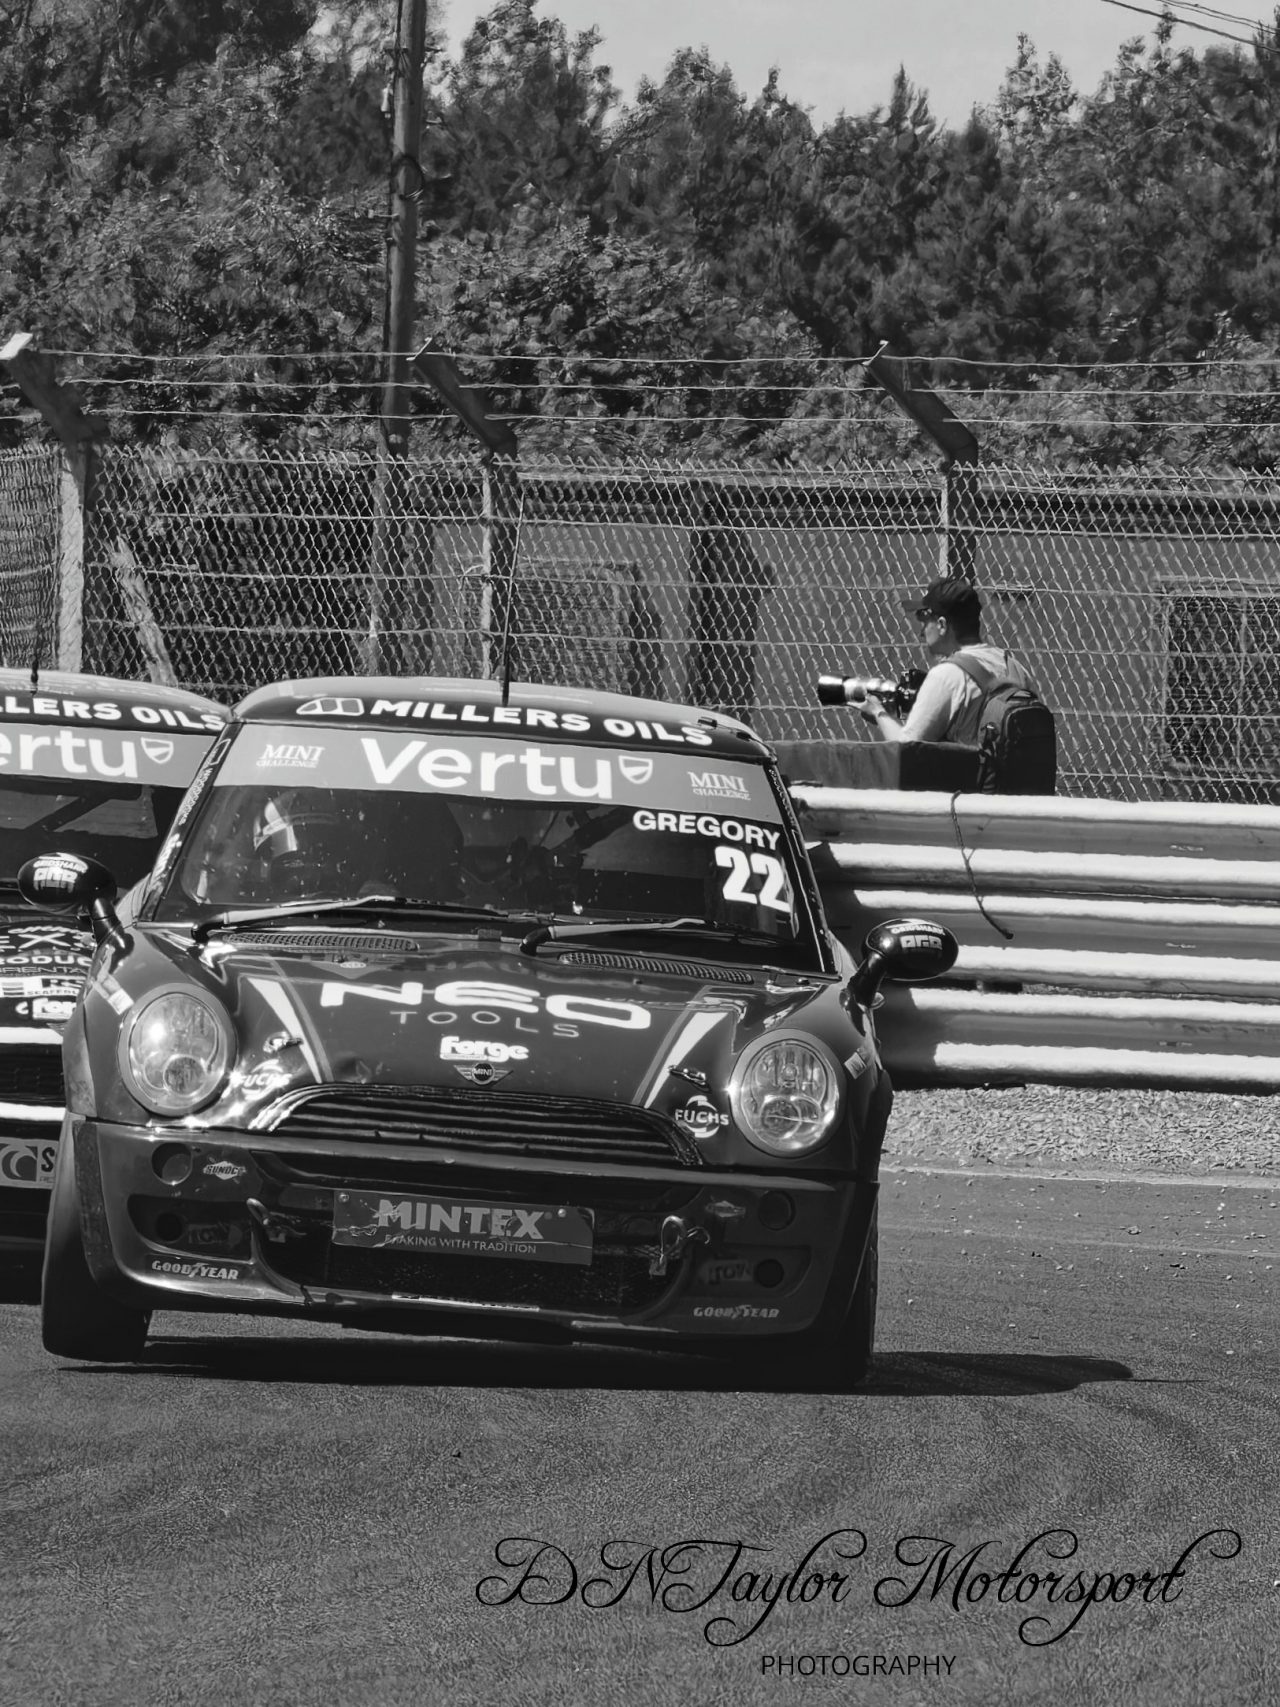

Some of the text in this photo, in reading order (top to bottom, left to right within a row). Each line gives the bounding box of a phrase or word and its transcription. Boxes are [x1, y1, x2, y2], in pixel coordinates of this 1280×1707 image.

[132, 706, 227, 730] OILS
[371, 700, 713, 747] MILLERS OILS
[258, 744, 326, 760] MINI
[360, 738, 614, 799] Vertu
[687, 771, 749, 793] MINI
[633, 810, 782, 851] GREGORY
[715, 845, 792, 914] 22
[320, 981, 651, 1029] NEO
[390, 1011, 580, 1038] TOOLS
[472, 1067, 493, 1076] MINI
[674, 1108, 730, 1126] FUCHS
[376, 1199, 545, 1240] MINTEX
[439, 1237, 470, 1249] WITH
[472, 1240, 537, 1254] TRADITION
[151, 1259, 240, 1280] GOODYEAR
